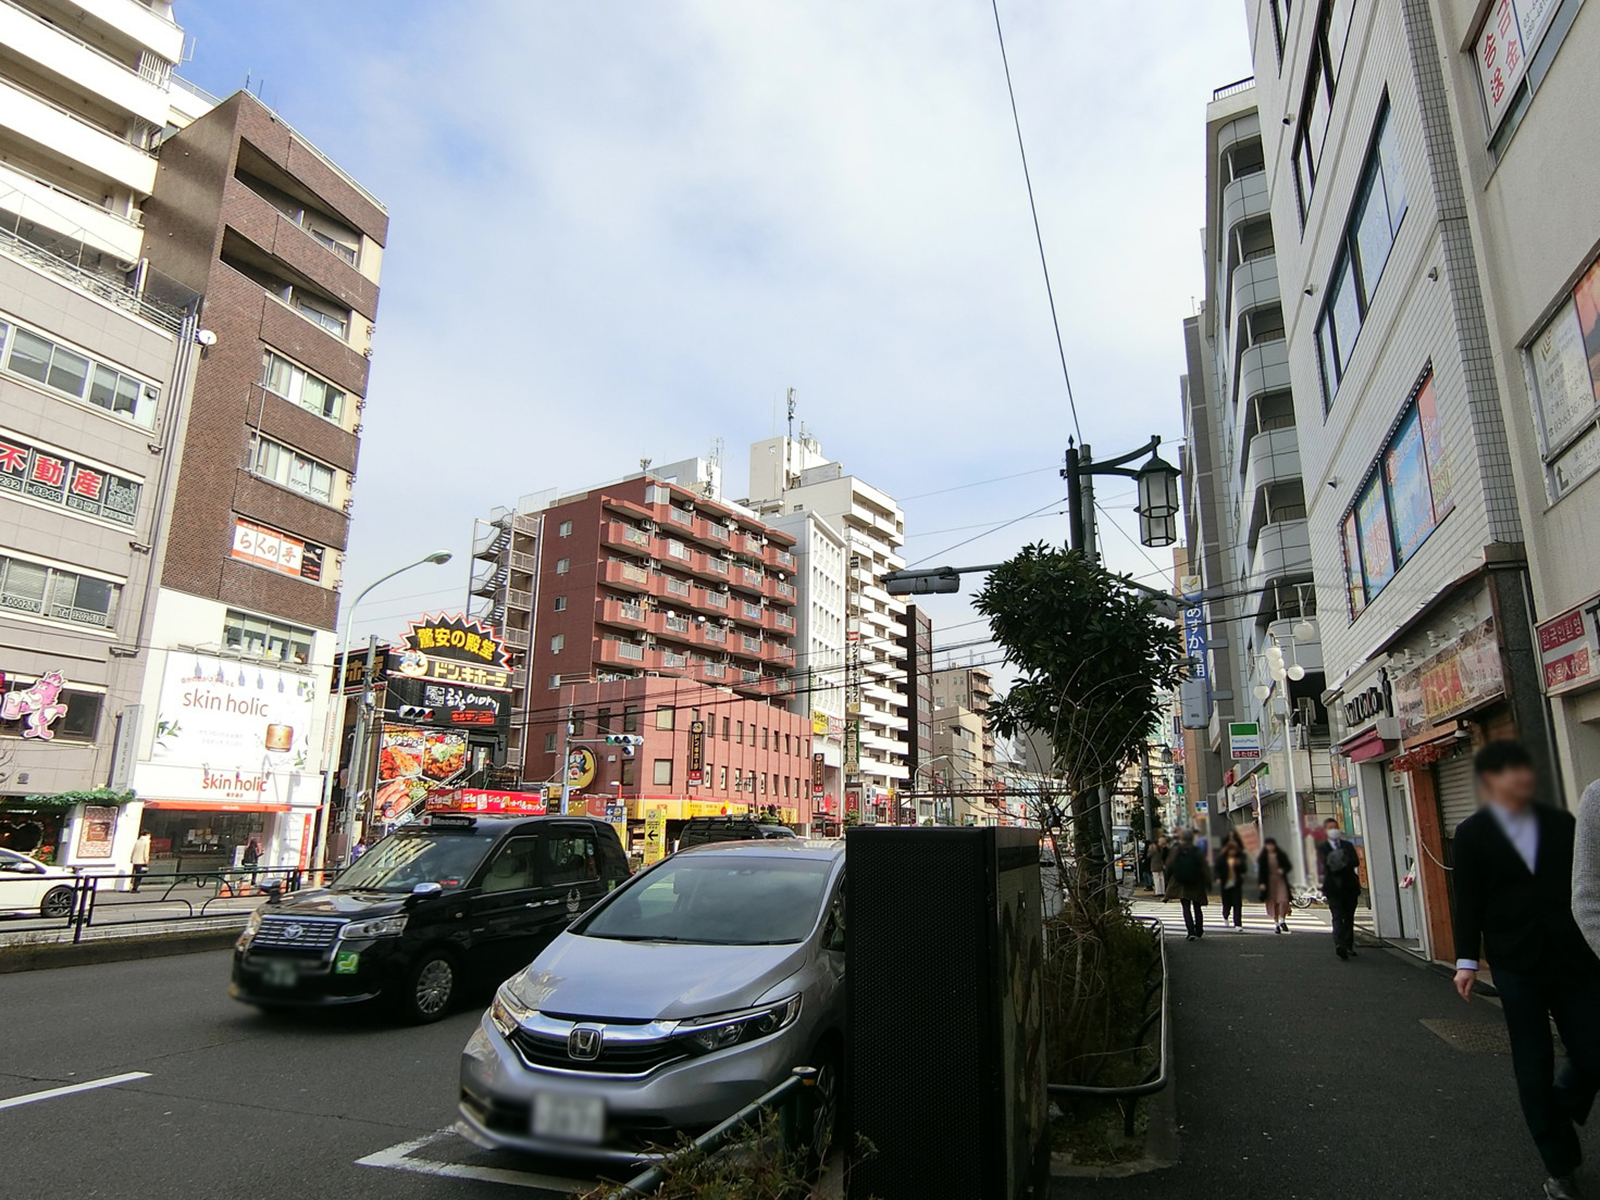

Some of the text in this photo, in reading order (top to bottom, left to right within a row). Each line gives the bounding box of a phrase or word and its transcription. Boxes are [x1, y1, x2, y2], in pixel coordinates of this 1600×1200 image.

[1490, 40, 1521, 107] 送金
[0, 442, 102, 500] 不動産
[240, 532, 297, 563] らくの手
[418, 628, 497, 661] 驚安の殿堂
[183, 688, 269, 717] skin holic
[202, 773, 268, 792] skin holic
